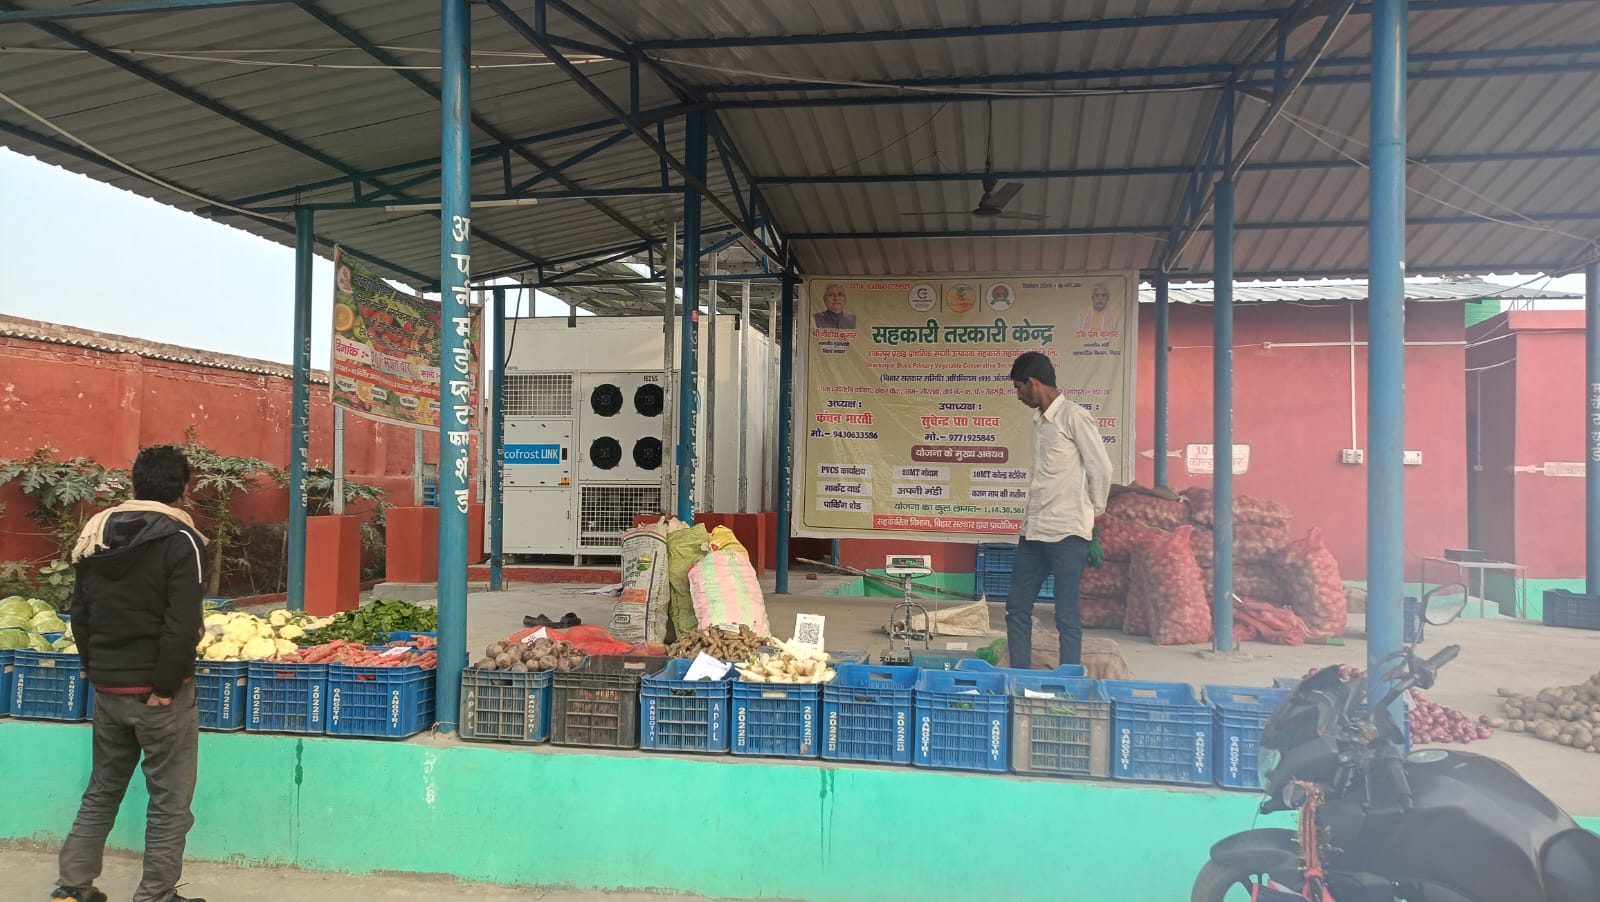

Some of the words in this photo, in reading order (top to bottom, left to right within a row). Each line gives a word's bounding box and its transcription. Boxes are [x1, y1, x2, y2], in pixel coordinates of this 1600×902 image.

[872, 318, 939, 344] सहकारी
[944, 318, 1007, 344] तरकारी
[1012, 319, 1054, 345] केन्द्र
[827, 400, 856, 408] अध्यक्ष
[938, 402, 976, 411] उपाध्यक्ष
[816, 411, 842, 424] कंचन
[973, 417, 1000, 427] यादव
[949, 433, 995, 442] 9771925845
[504, 449, 540, 459] cofrost
[541, 449, 558, 459] LINK
[915, 447, 942, 458] योजना
[944, 446, 953, 457] के
[956, 449, 975, 461] मुख्य
[840, 466, 866, 476] कार्यालय
[824, 483, 846, 493] मार्केट
[846, 484, 861, 494] यार्ड
[897, 486, 923, 497] अपनी
[925, 486, 942, 497] मंडी
[999, 489, 1008, 499] की
[849, 500, 861, 510] शेड
[895, 502, 921, 511] योजना
[922, 503, 933, 511] का
[935, 503, 951, 515] कुल
[877, 517, 909, 527] सहकारिता
[934, 517, 952, 528] बिहार
[952, 519, 975, 529] सरकार
[922, 716, 930, 757] GANGOTRI
[991, 719, 1000, 760] GANGOTRI
